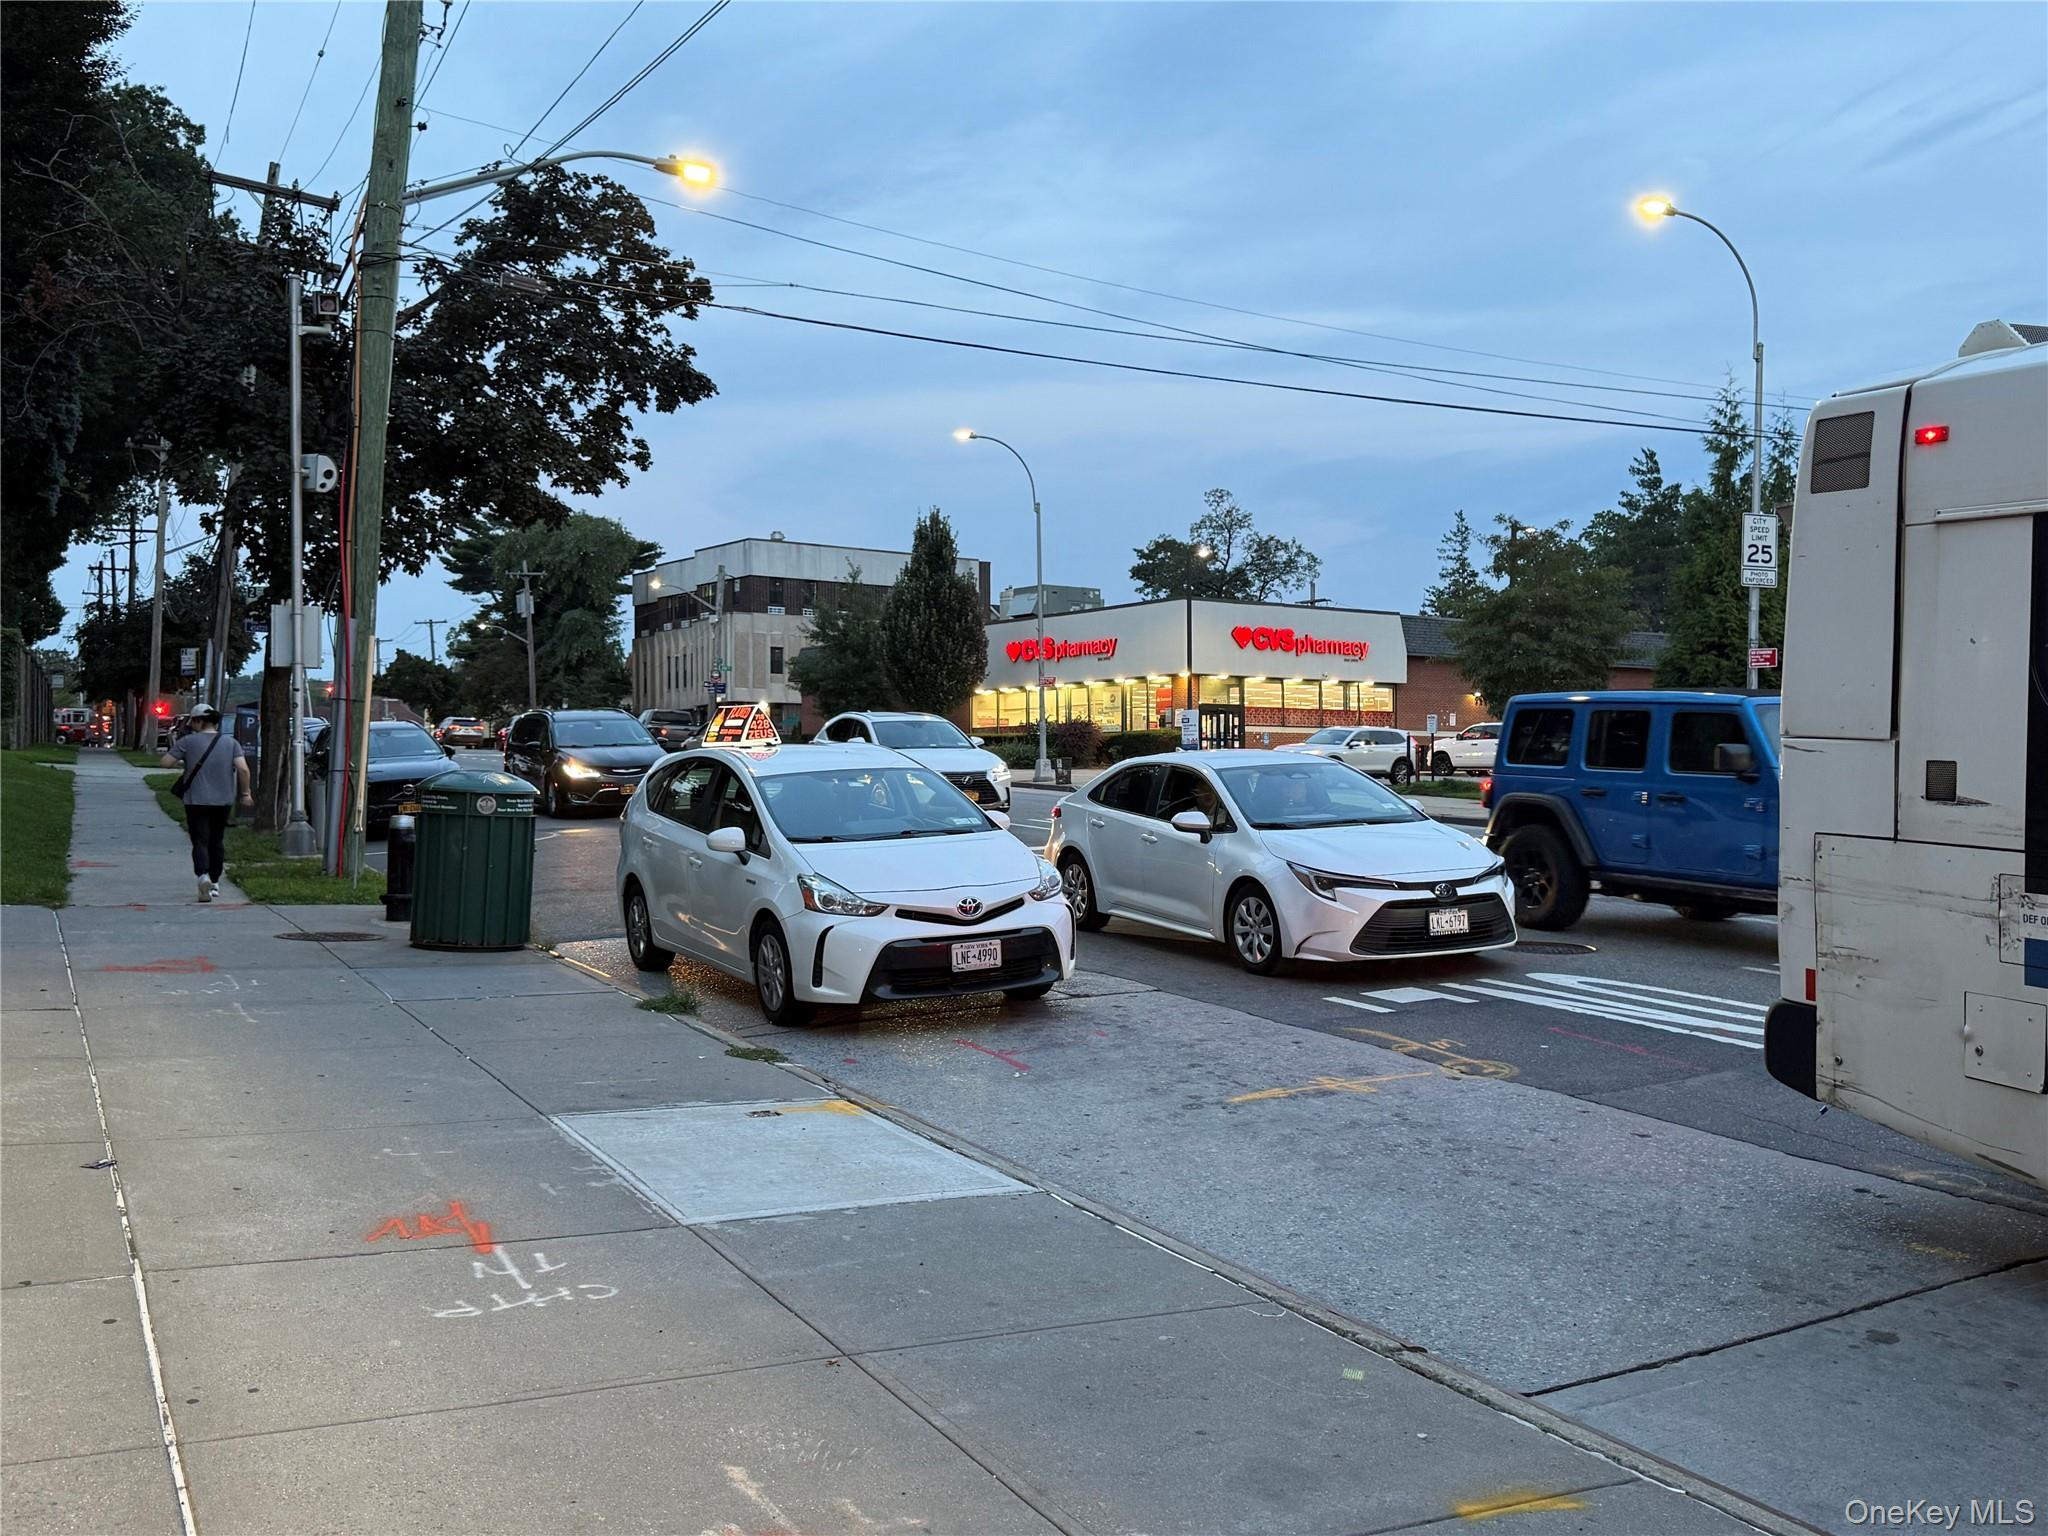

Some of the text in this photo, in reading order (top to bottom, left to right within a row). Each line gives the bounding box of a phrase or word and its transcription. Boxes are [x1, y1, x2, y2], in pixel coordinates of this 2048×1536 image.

[1748, 545, 1772, 563] 25
[1055, 638, 1118, 662] pharmacy
[1252, 626, 1370, 660] CVS pharmacy
[751, 720, 770, 729] 428
[748, 729, 774, 739] ZEUS
[2023, 914, 2048, 926] DEF O
